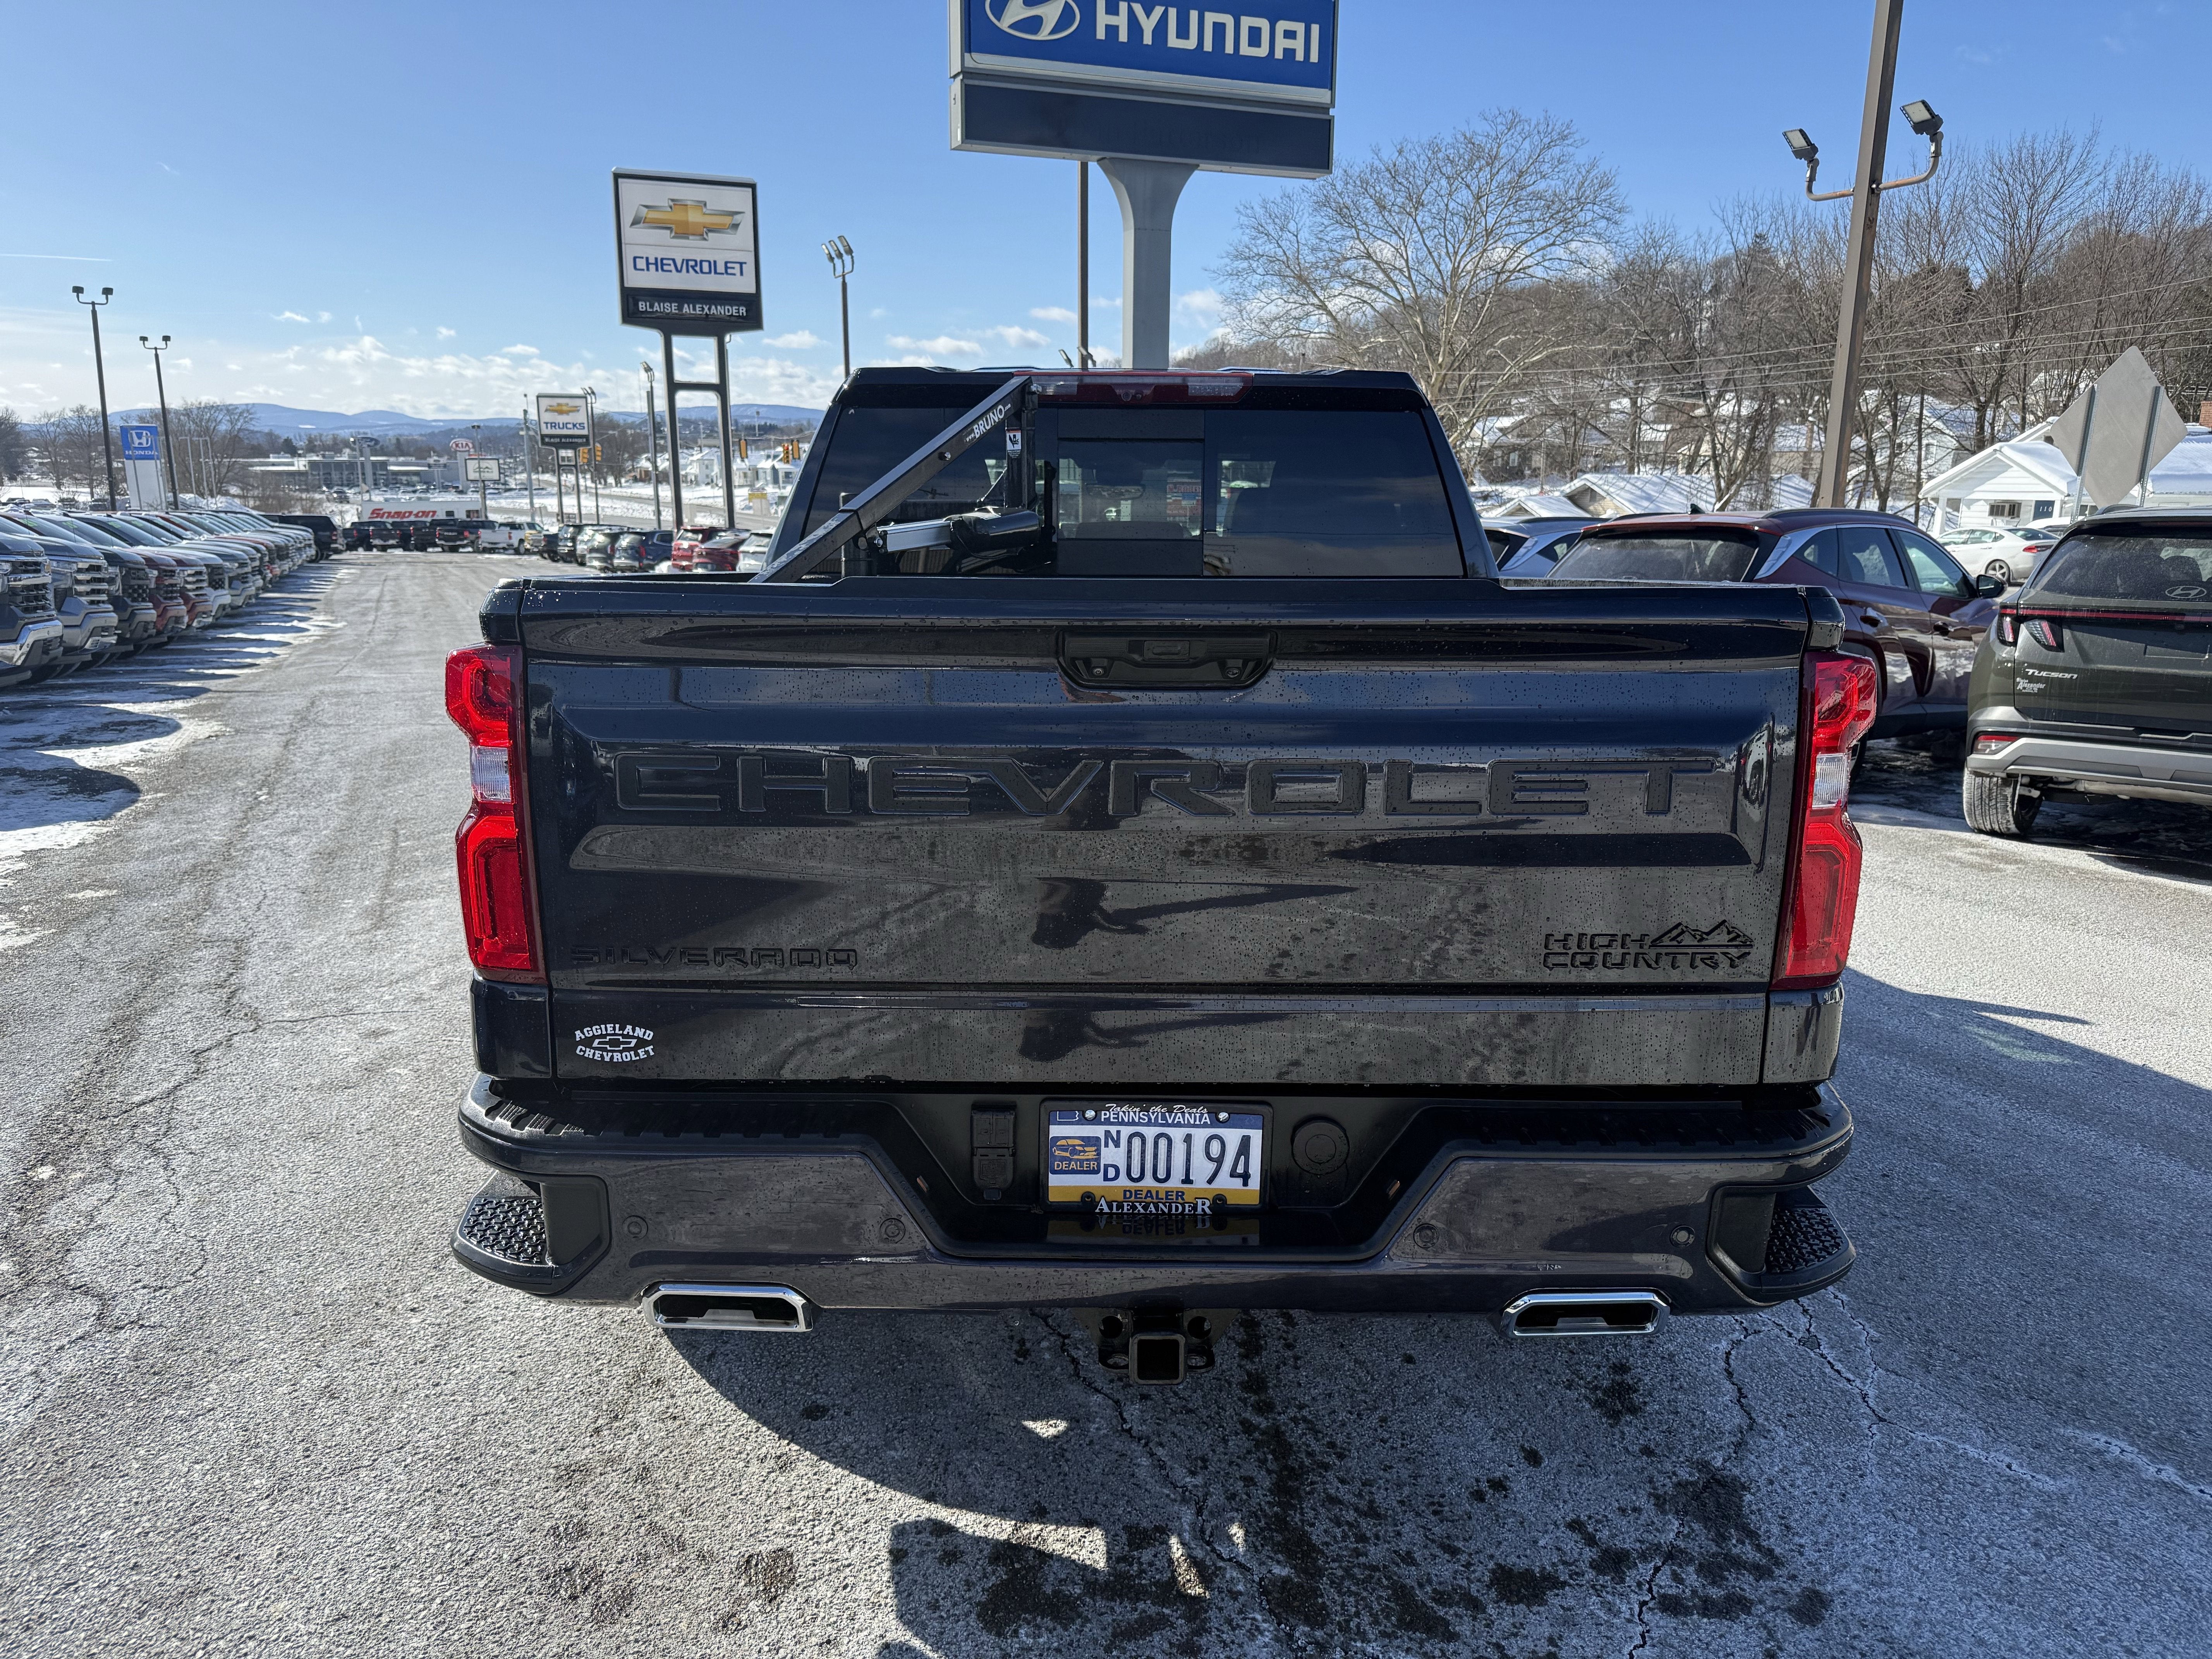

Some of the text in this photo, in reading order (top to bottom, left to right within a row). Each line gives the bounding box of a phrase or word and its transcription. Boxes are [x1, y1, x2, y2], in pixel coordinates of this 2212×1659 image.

[1096, 0, 1319, 63] HYUNDAI
[633, 256, 747, 276] CHEVROLET
[639, 301, 746, 316] BLAISE ALEXANDER
[543, 422, 585, 430] TRUCKS
[369, 508, 437, 520] Snap-on
[615, 753, 1718, 816] CHEVROLET
[1544, 933, 1650, 950] HIGH
[570, 947, 858, 968] SILVERADO
[1543, 952, 1751, 969] COUNTRY
[575, 1024, 654, 1041] AGGIELAND
[576, 1045, 655, 1062] CHEVROLET
[1105, 1104, 1208, 1113] Takin' the Deals
[1101, 1111, 1211, 1124] PENNSYLVANIA
[1054, 1162, 1097, 1170] DEALER
[1126, 1132, 1251, 1187] 00194
[1123, 1189, 1185, 1201] DEALER
[1095, 1197, 1212, 1214] ALEXANDER
